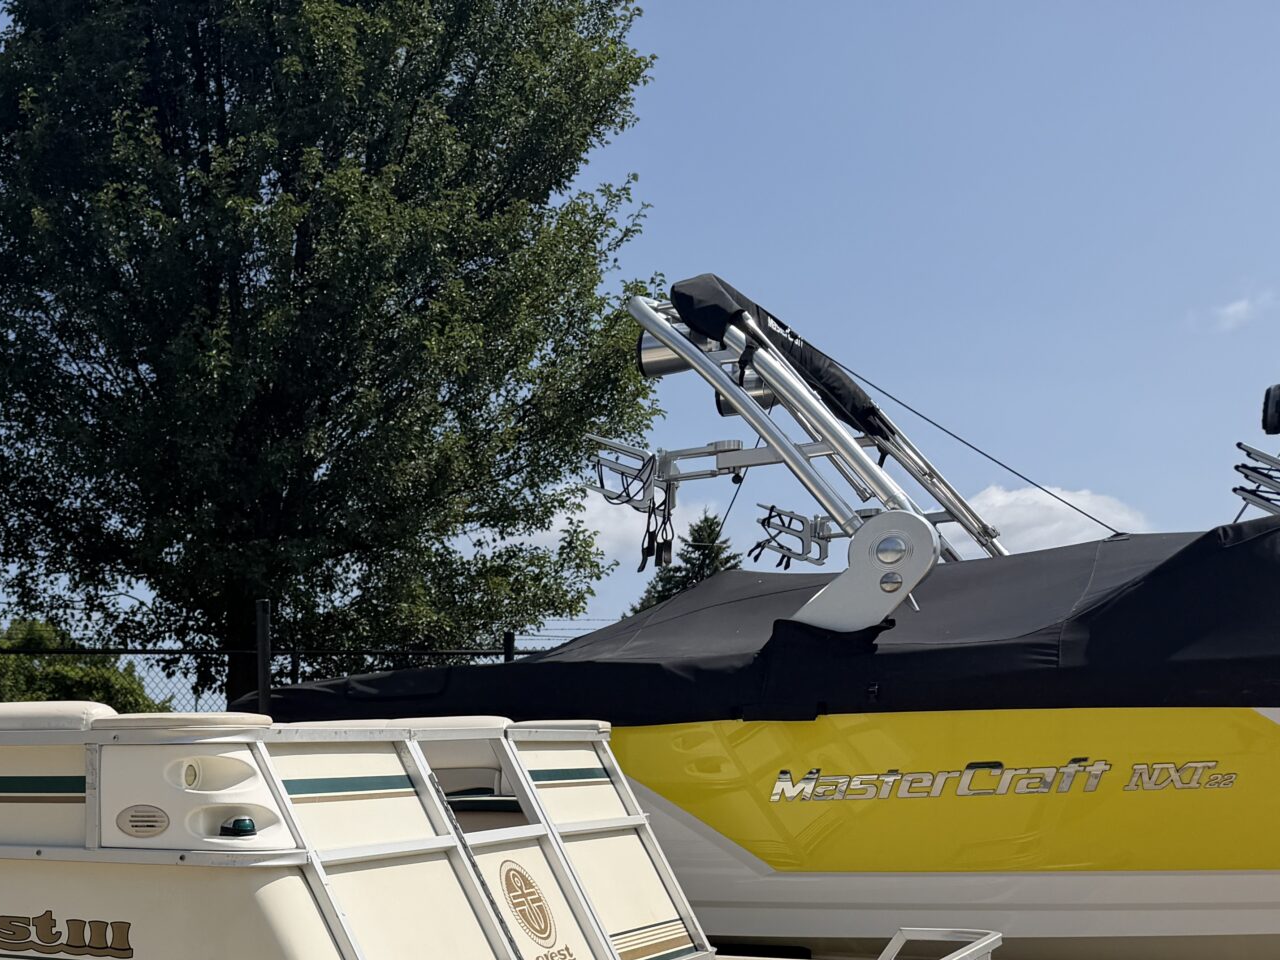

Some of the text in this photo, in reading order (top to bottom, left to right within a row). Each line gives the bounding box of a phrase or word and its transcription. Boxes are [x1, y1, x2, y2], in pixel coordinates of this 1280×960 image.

[769, 757, 1237, 802] MasterCraft NXT 22
